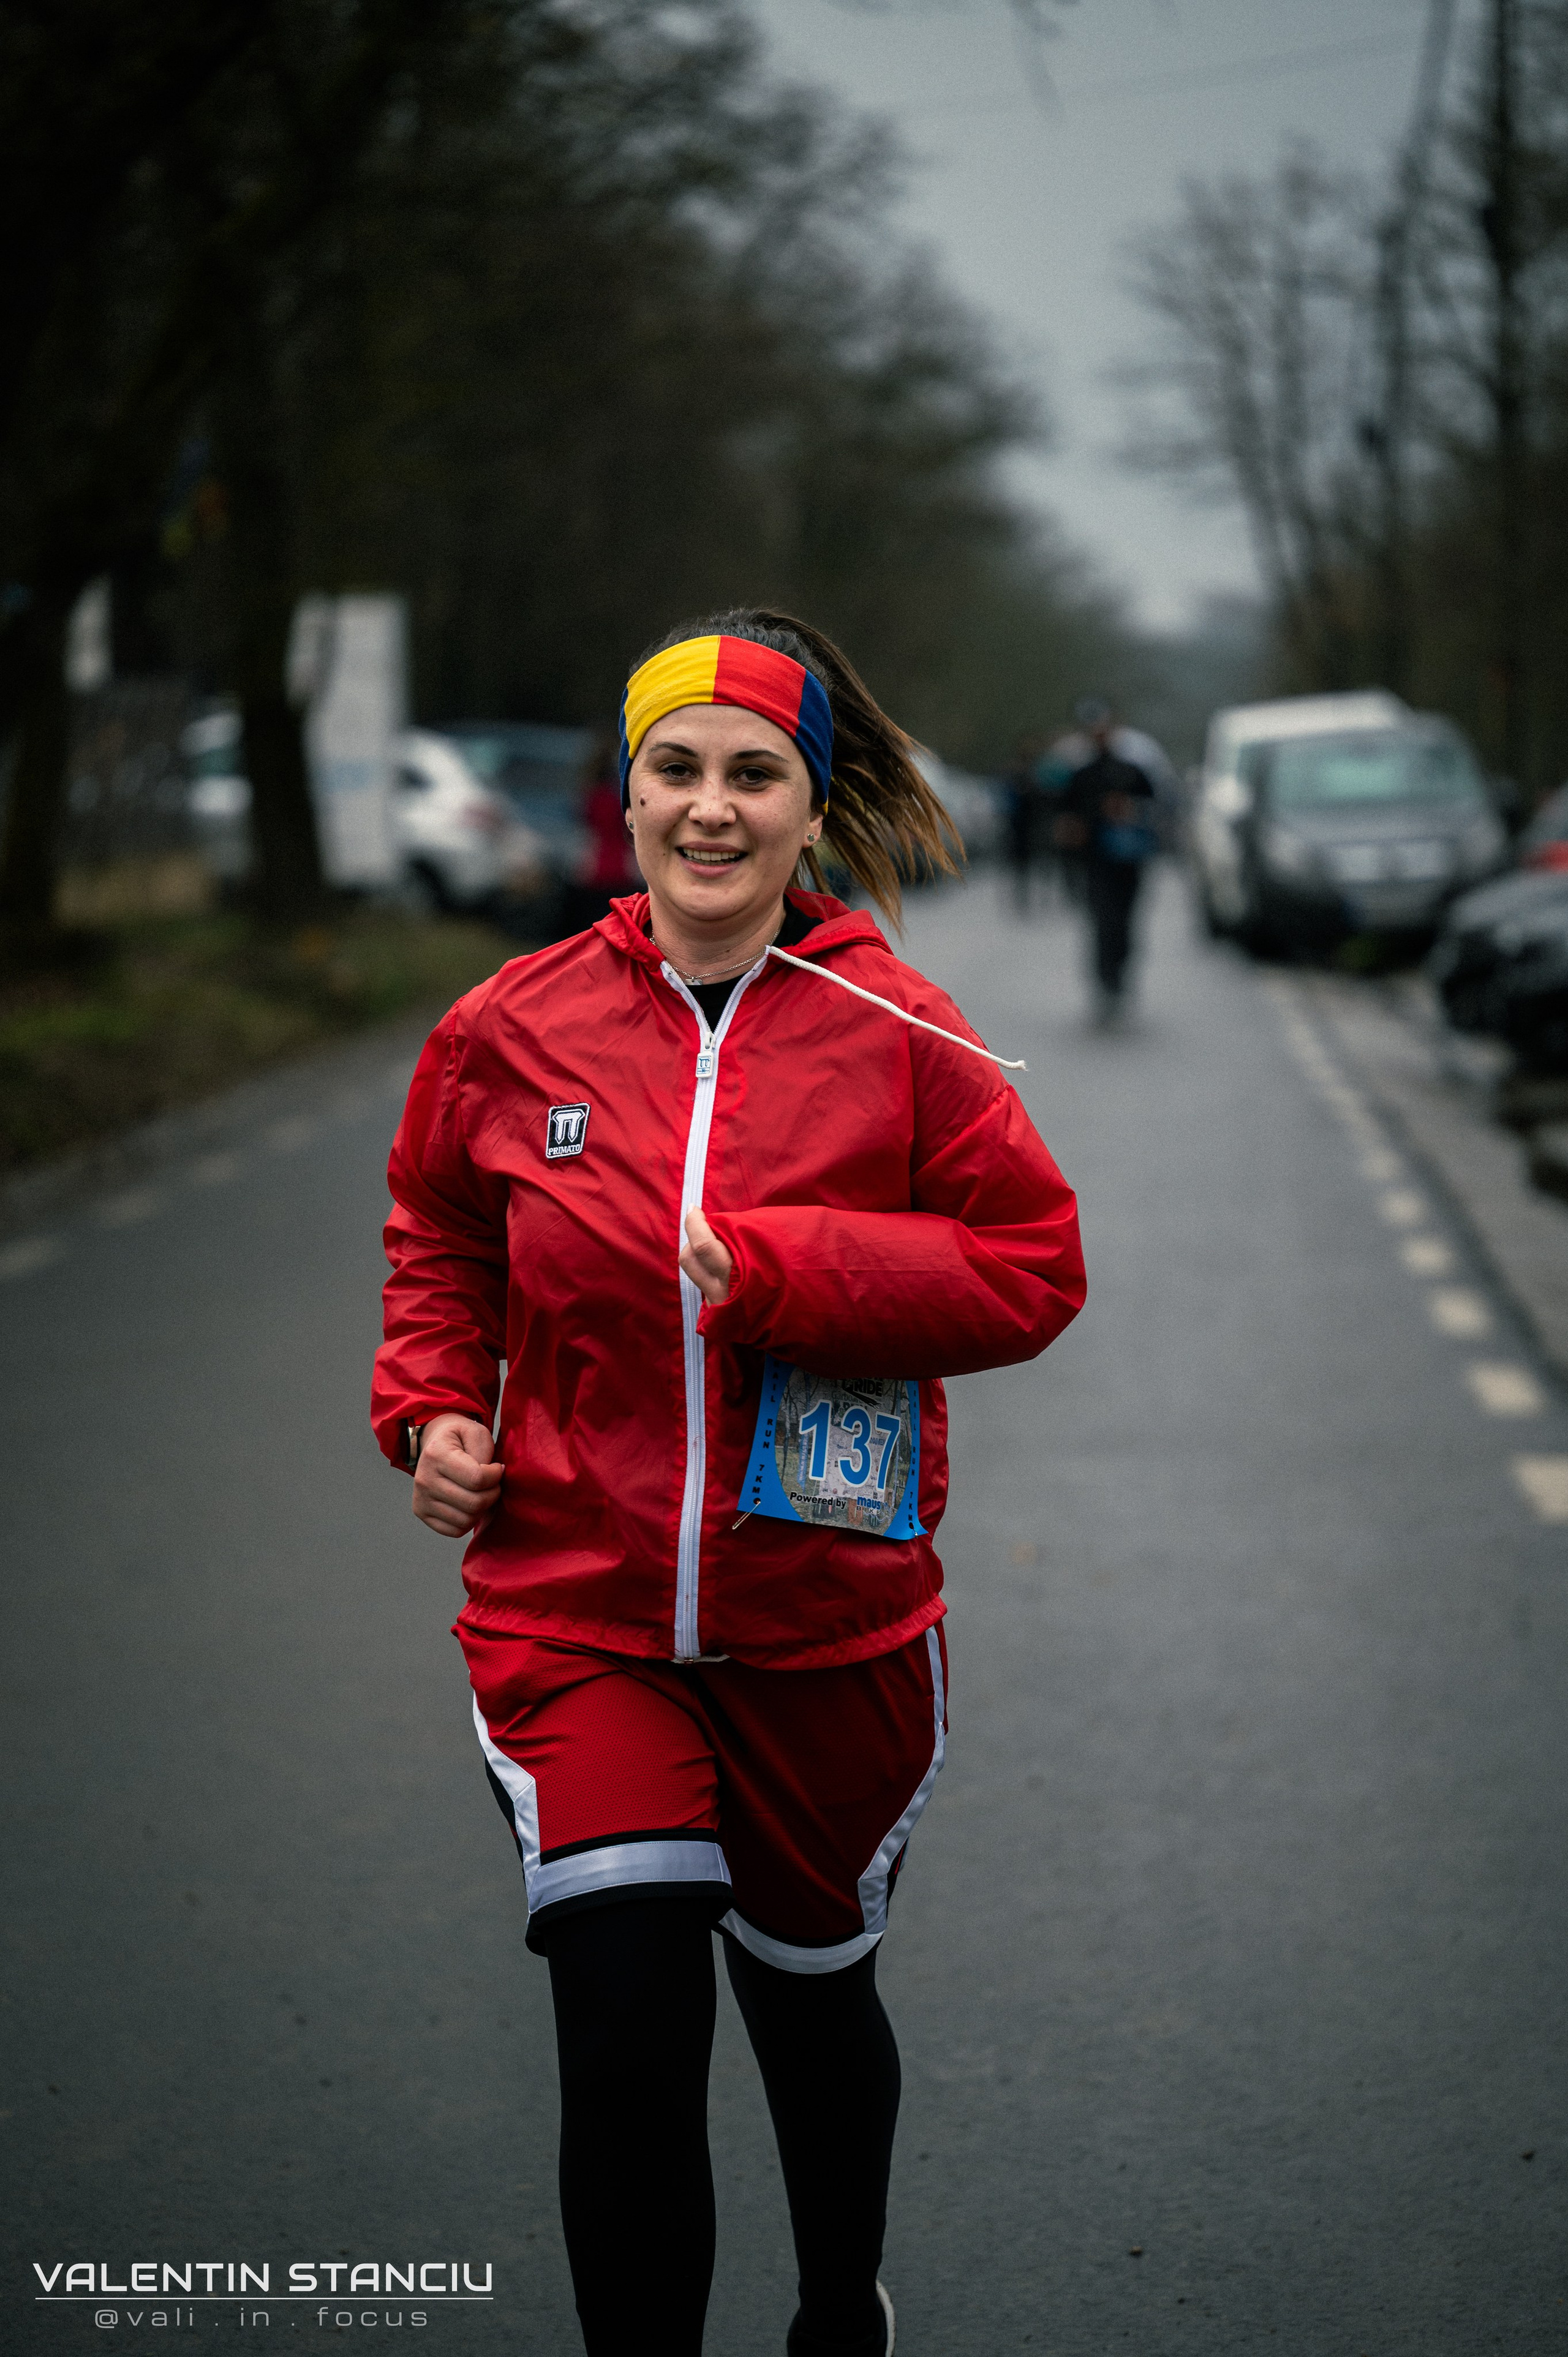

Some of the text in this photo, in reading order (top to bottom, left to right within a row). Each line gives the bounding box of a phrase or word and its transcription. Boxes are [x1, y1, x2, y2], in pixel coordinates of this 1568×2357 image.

[548, 1144, 580, 1156] PRIMATO
[763, 1419, 773, 1449] RUN
[800, 1401, 900, 1491] 137
[790, 1492, 846, 1509] Powered by
[857, 1496, 881, 1510] maus
